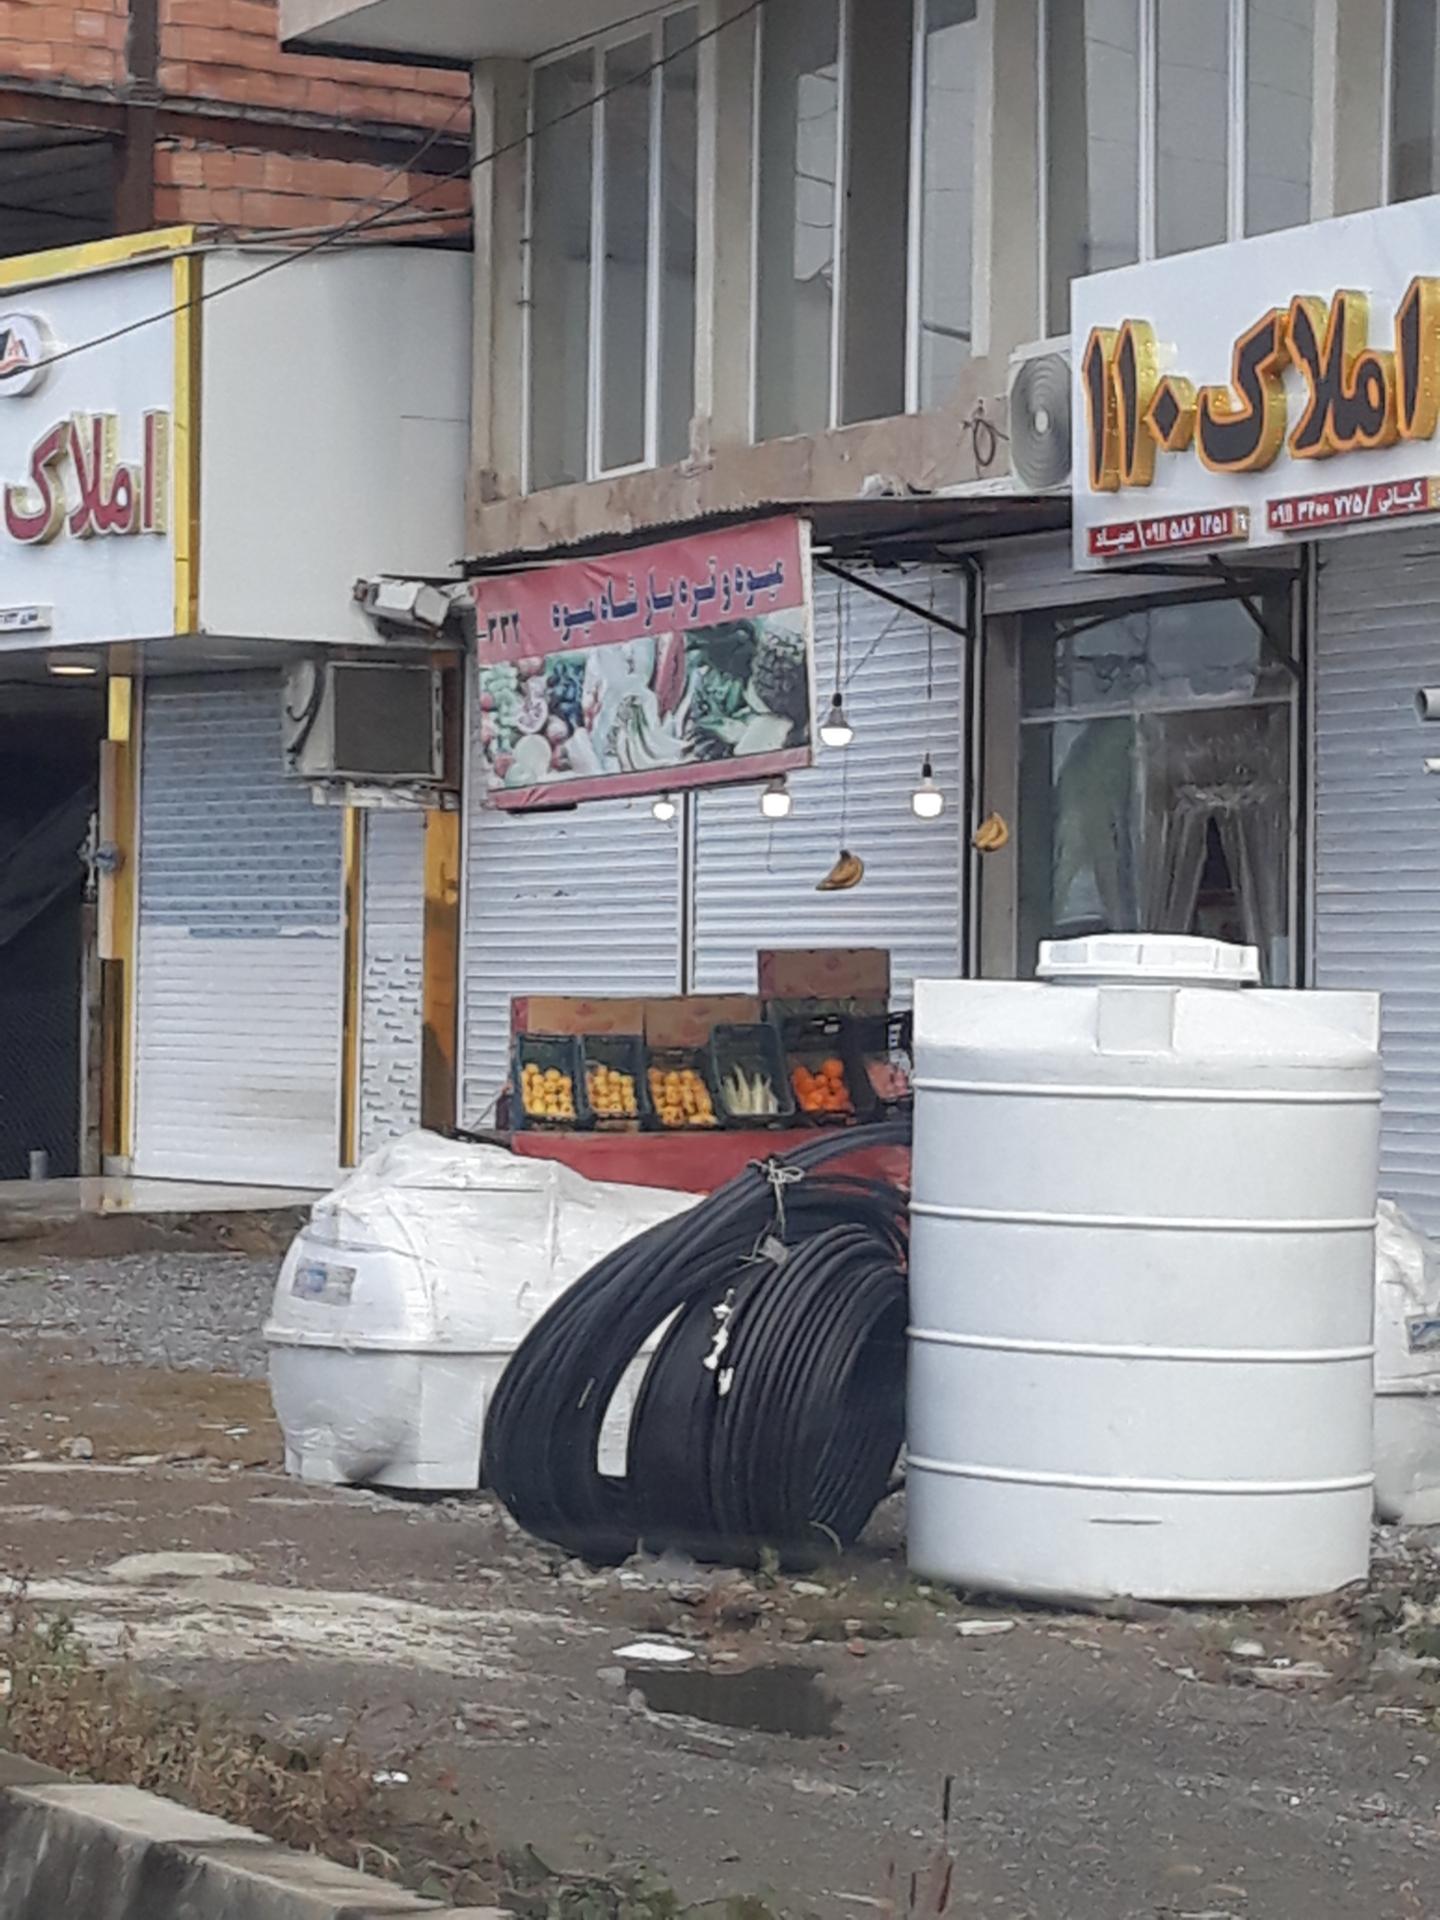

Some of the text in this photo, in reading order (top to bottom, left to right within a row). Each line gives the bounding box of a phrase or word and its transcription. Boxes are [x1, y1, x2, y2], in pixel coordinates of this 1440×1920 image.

[1082, 275, 1438, 493] املاک ۱۱۰
[3, 408, 171, 545] املاک
[600, 573, 639, 621] شاه
[720, 571, 732, 613] و
[734, 559, 784, 607] میوه
[551, 596, 597, 643] میوه
